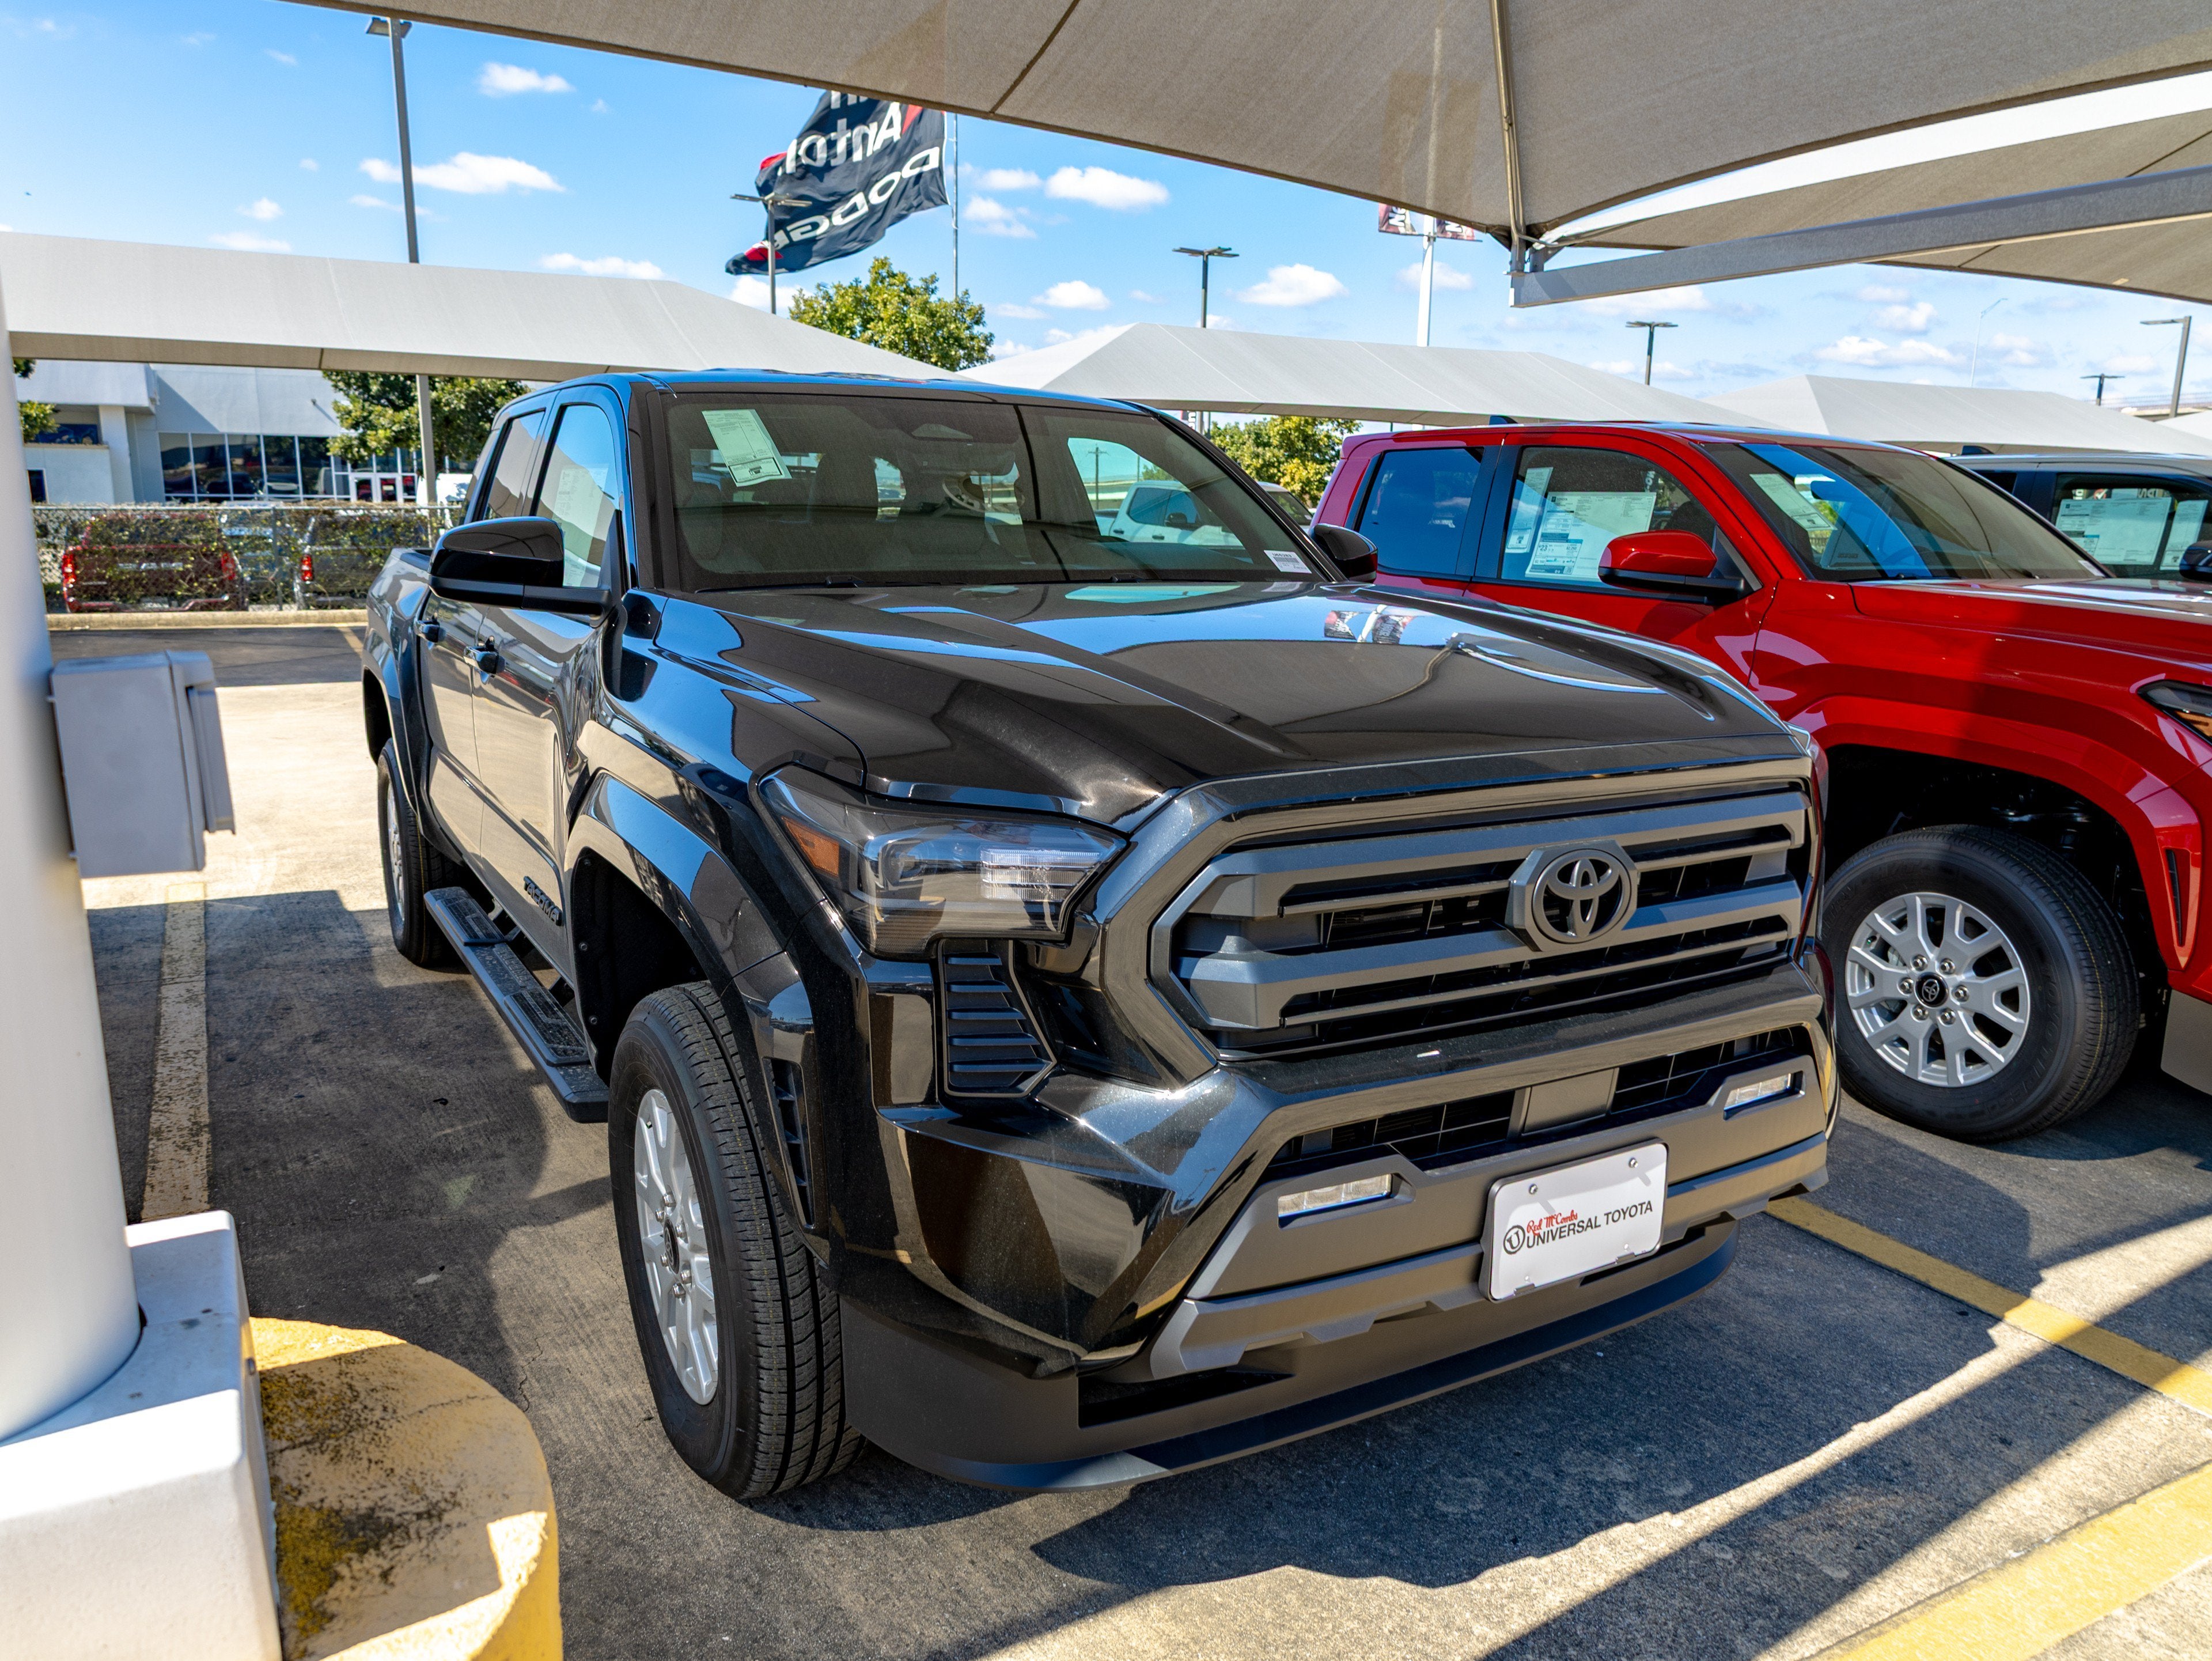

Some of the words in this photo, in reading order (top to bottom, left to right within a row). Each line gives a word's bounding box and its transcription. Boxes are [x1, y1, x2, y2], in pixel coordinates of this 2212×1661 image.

[523, 875, 563, 926] TACOMA
[1527, 1218, 1543, 1236] Red
[1544, 1209, 1578, 1229] McCombs
[1527, 1216, 1601, 1248] UNIVERSAL
[1604, 1200, 1653, 1225] TOYOTA
